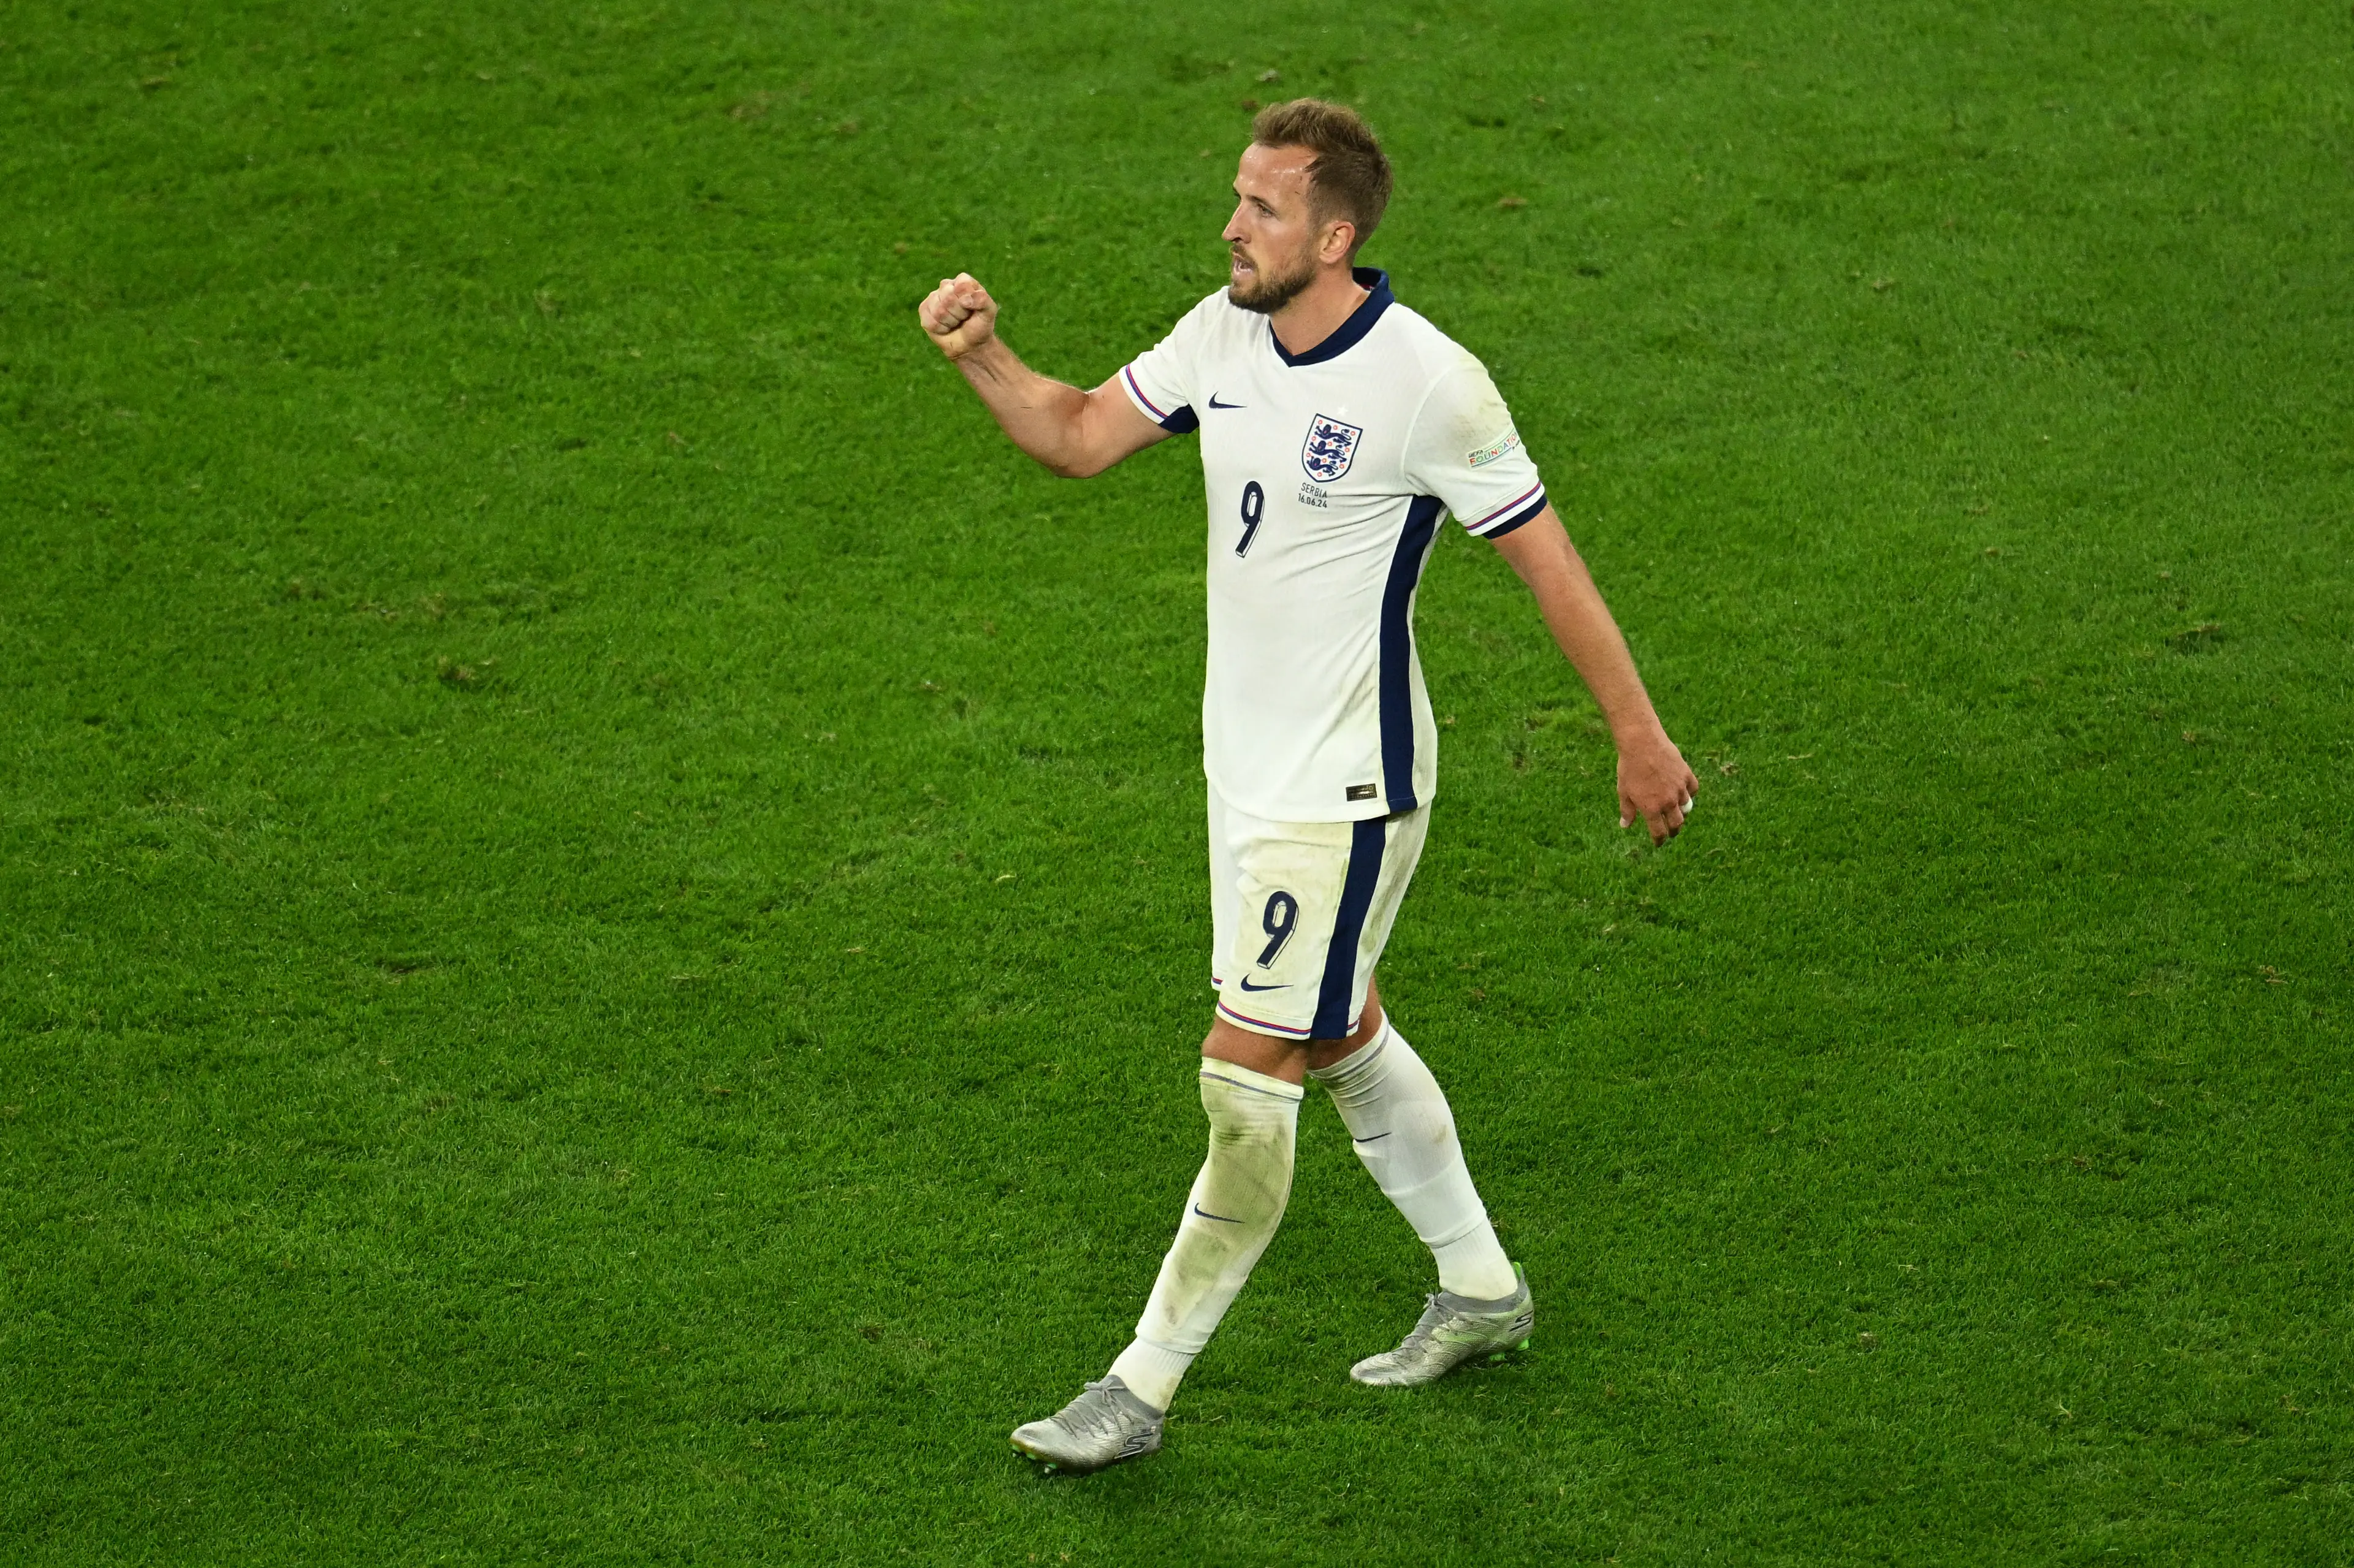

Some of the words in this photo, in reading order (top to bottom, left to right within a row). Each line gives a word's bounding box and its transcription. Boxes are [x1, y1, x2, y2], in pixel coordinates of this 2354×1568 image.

[1298, 493, 1327, 508] 16.06.24
[1301, 482, 1327, 498] SERBIA
[1235, 481, 1265, 558] 9
[1257, 891, 1299, 970] 9
